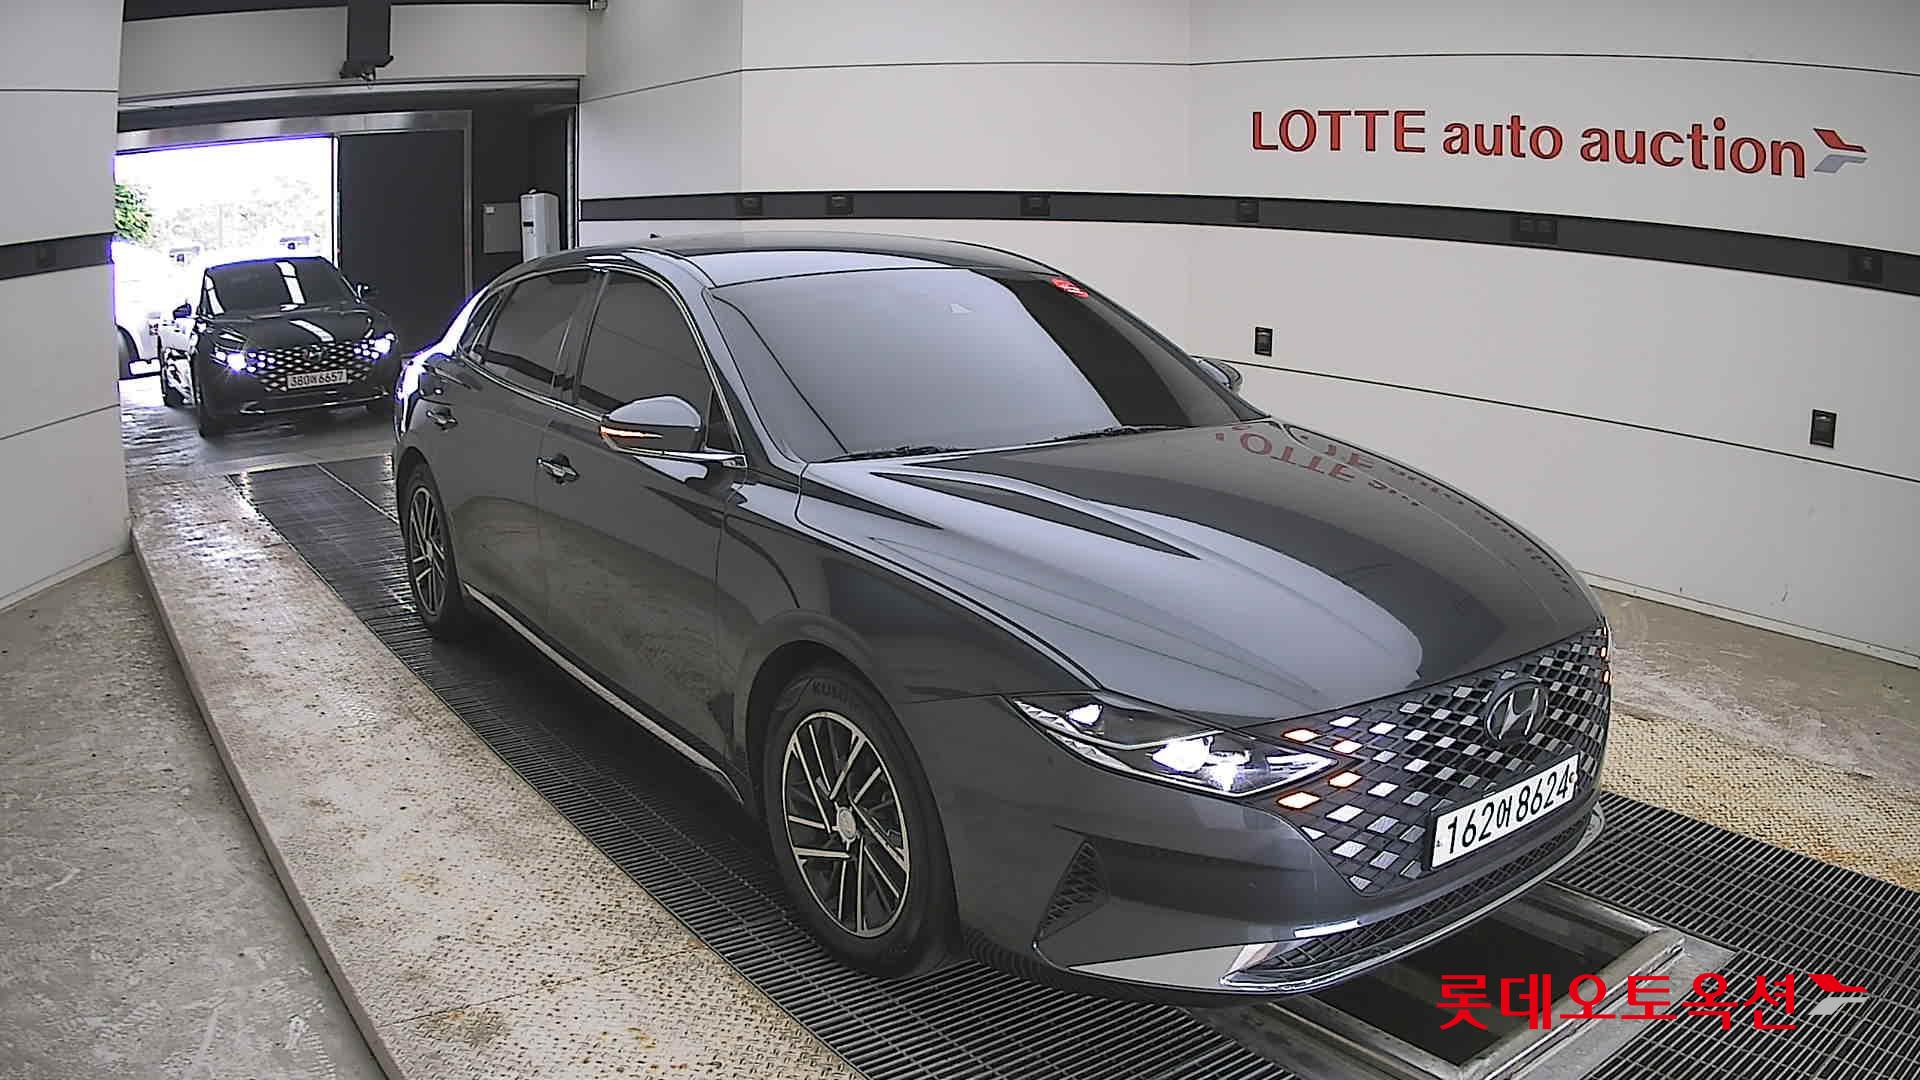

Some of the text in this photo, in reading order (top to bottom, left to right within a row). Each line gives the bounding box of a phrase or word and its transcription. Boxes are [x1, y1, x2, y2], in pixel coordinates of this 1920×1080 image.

[1252, 110, 1805, 178] LOTTE auto auction
